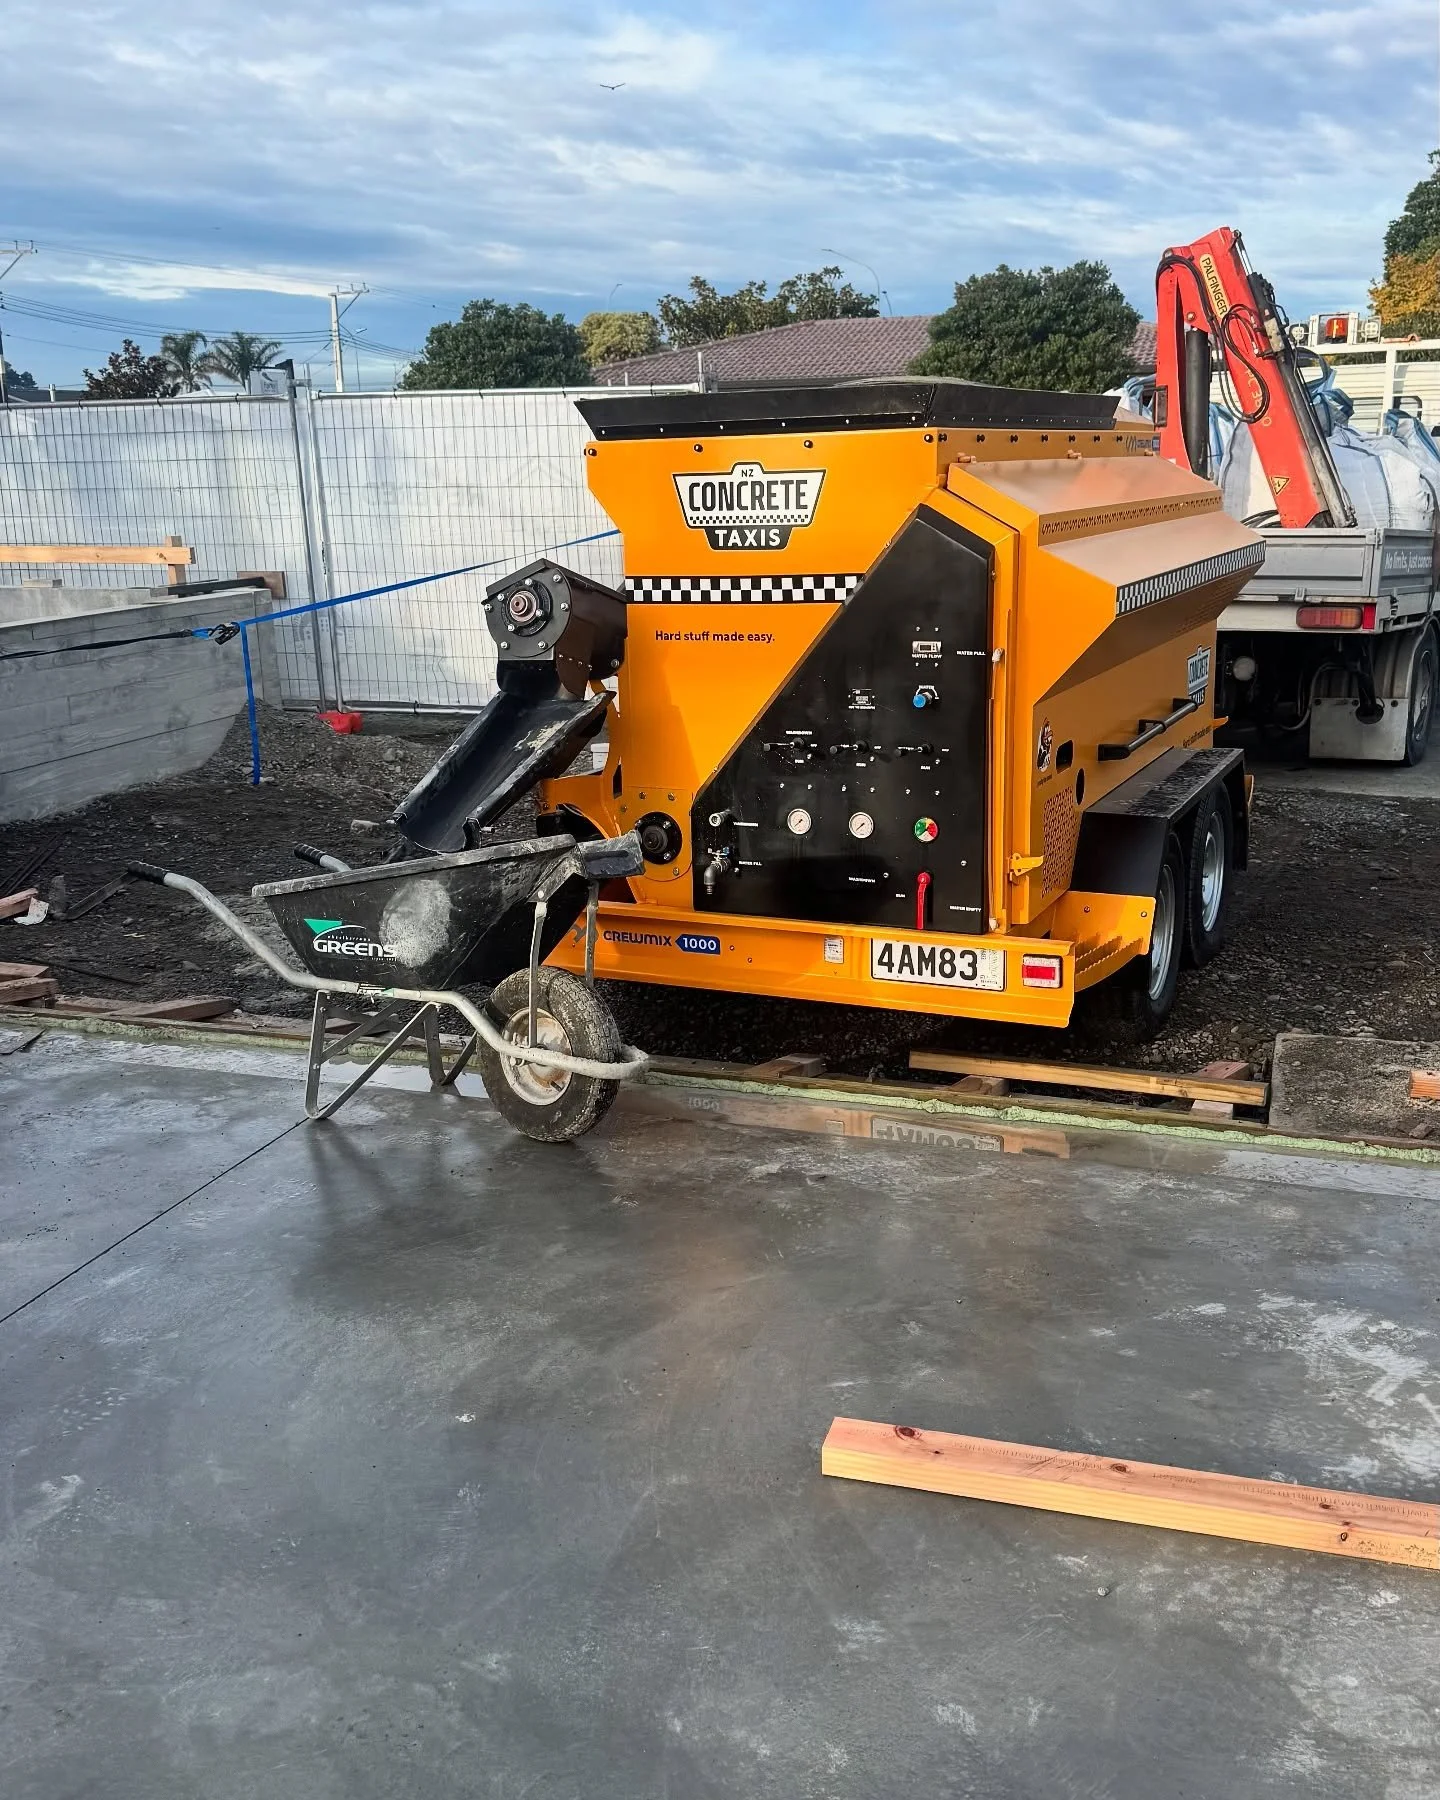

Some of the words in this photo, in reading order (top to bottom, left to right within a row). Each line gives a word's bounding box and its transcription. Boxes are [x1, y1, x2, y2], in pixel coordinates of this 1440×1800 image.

[1201, 256, 1228, 316] PALFINGER
[741, 468, 755, 478] NZ
[688, 479, 808, 512] CONCRETE
[714, 528, 781, 547] TAXIS
[655, 630, 681, 641] Hard
[683, 630, 710, 642] stuff
[712, 631, 745, 642] made
[747, 632, 776, 644] easy.
[313, 939, 398, 958] GREENS
[603, 930, 673, 947] CREWMIX
[682, 937, 717, 951] 1000
[877, 942, 979, 981] 4AM83
